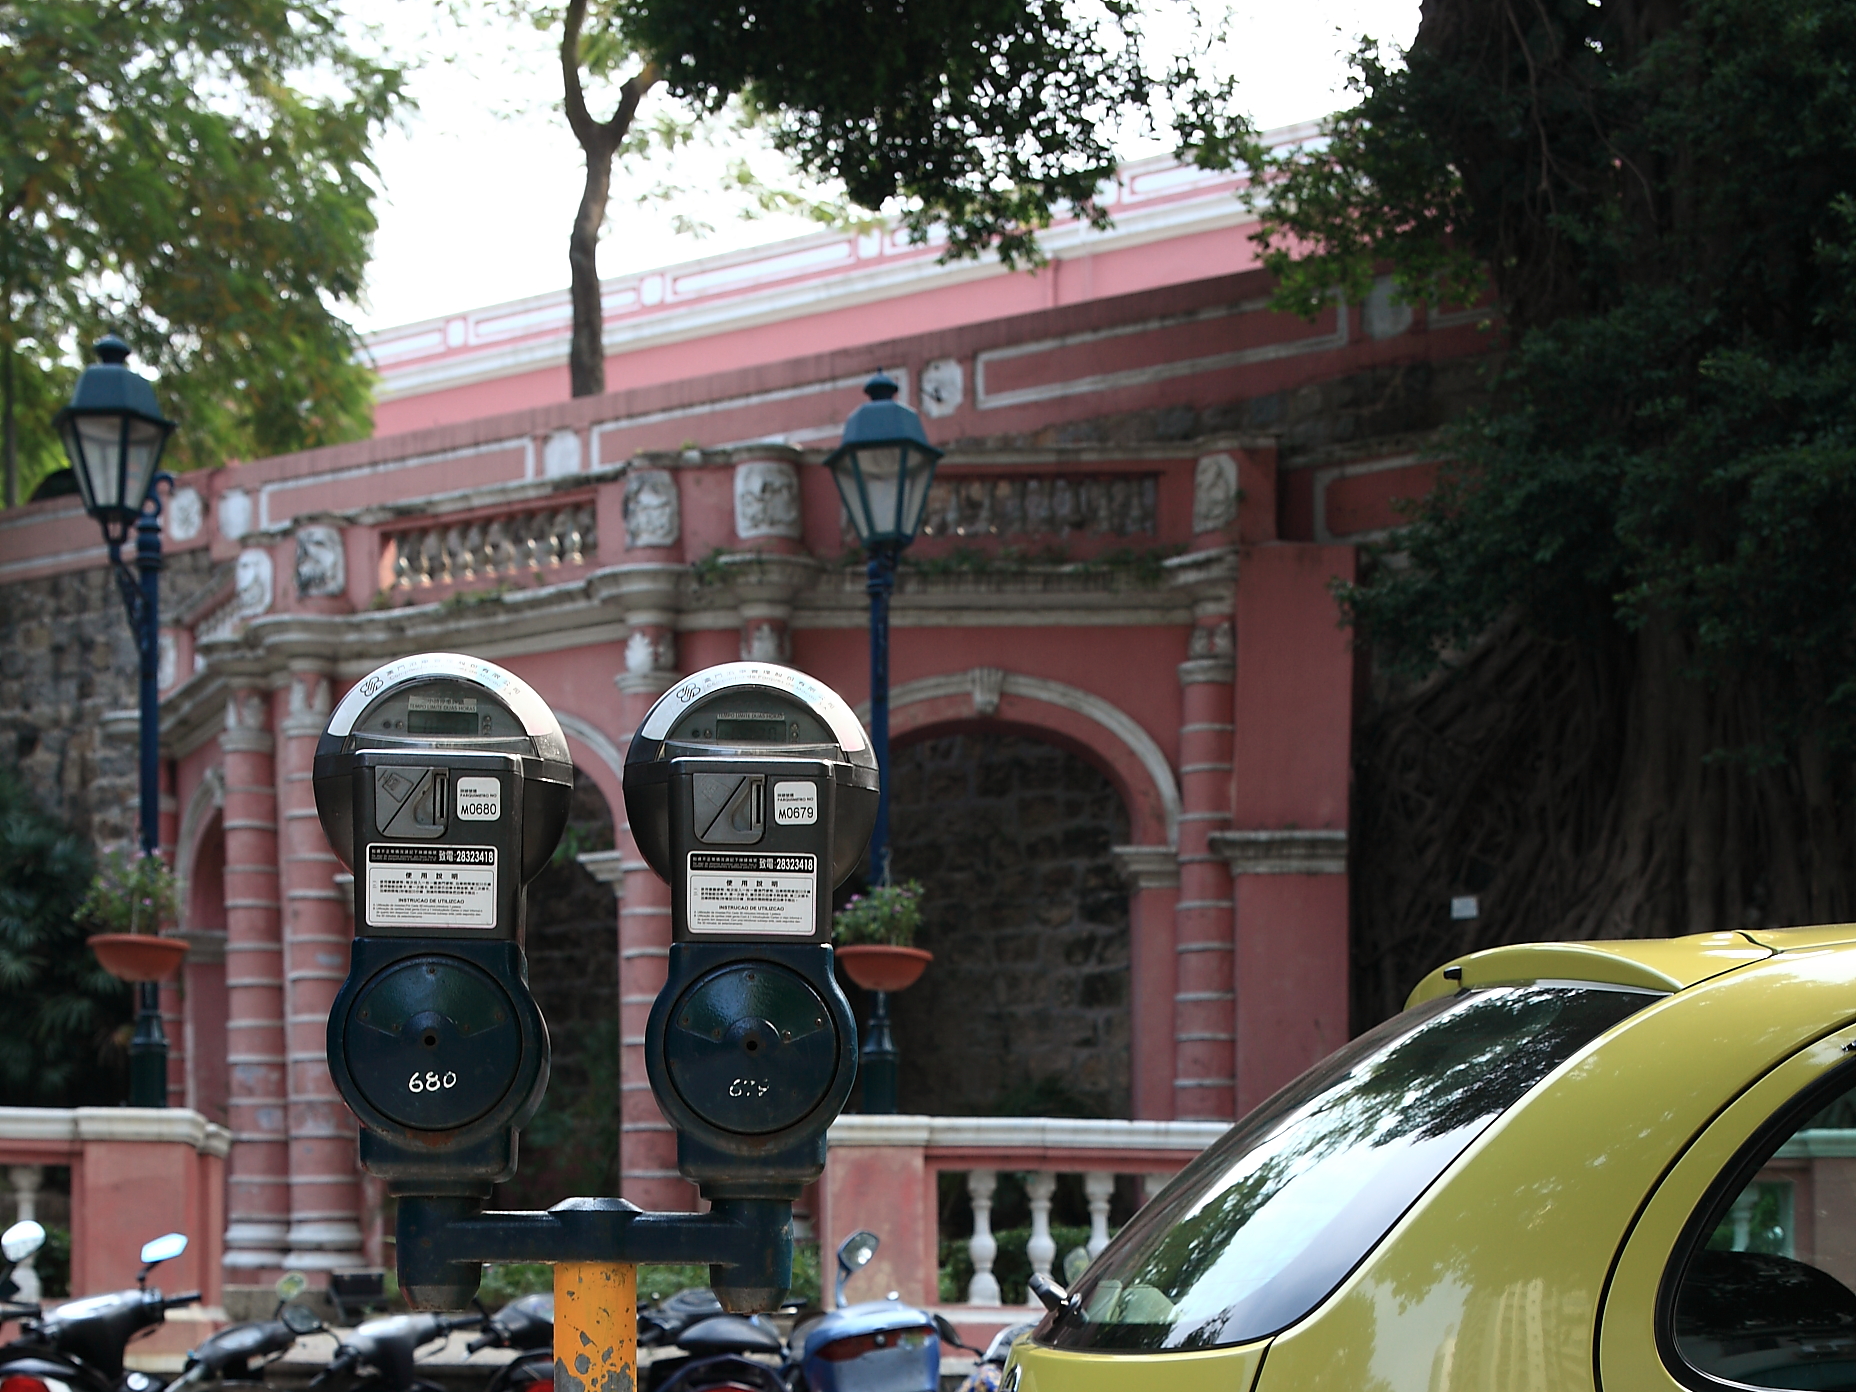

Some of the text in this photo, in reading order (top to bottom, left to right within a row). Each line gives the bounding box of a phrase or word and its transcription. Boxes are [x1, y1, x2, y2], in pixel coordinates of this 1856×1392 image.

[460, 803, 497, 815] M0680
[778, 806, 814, 819] M0679
[408, 1070, 457, 1093] 680
